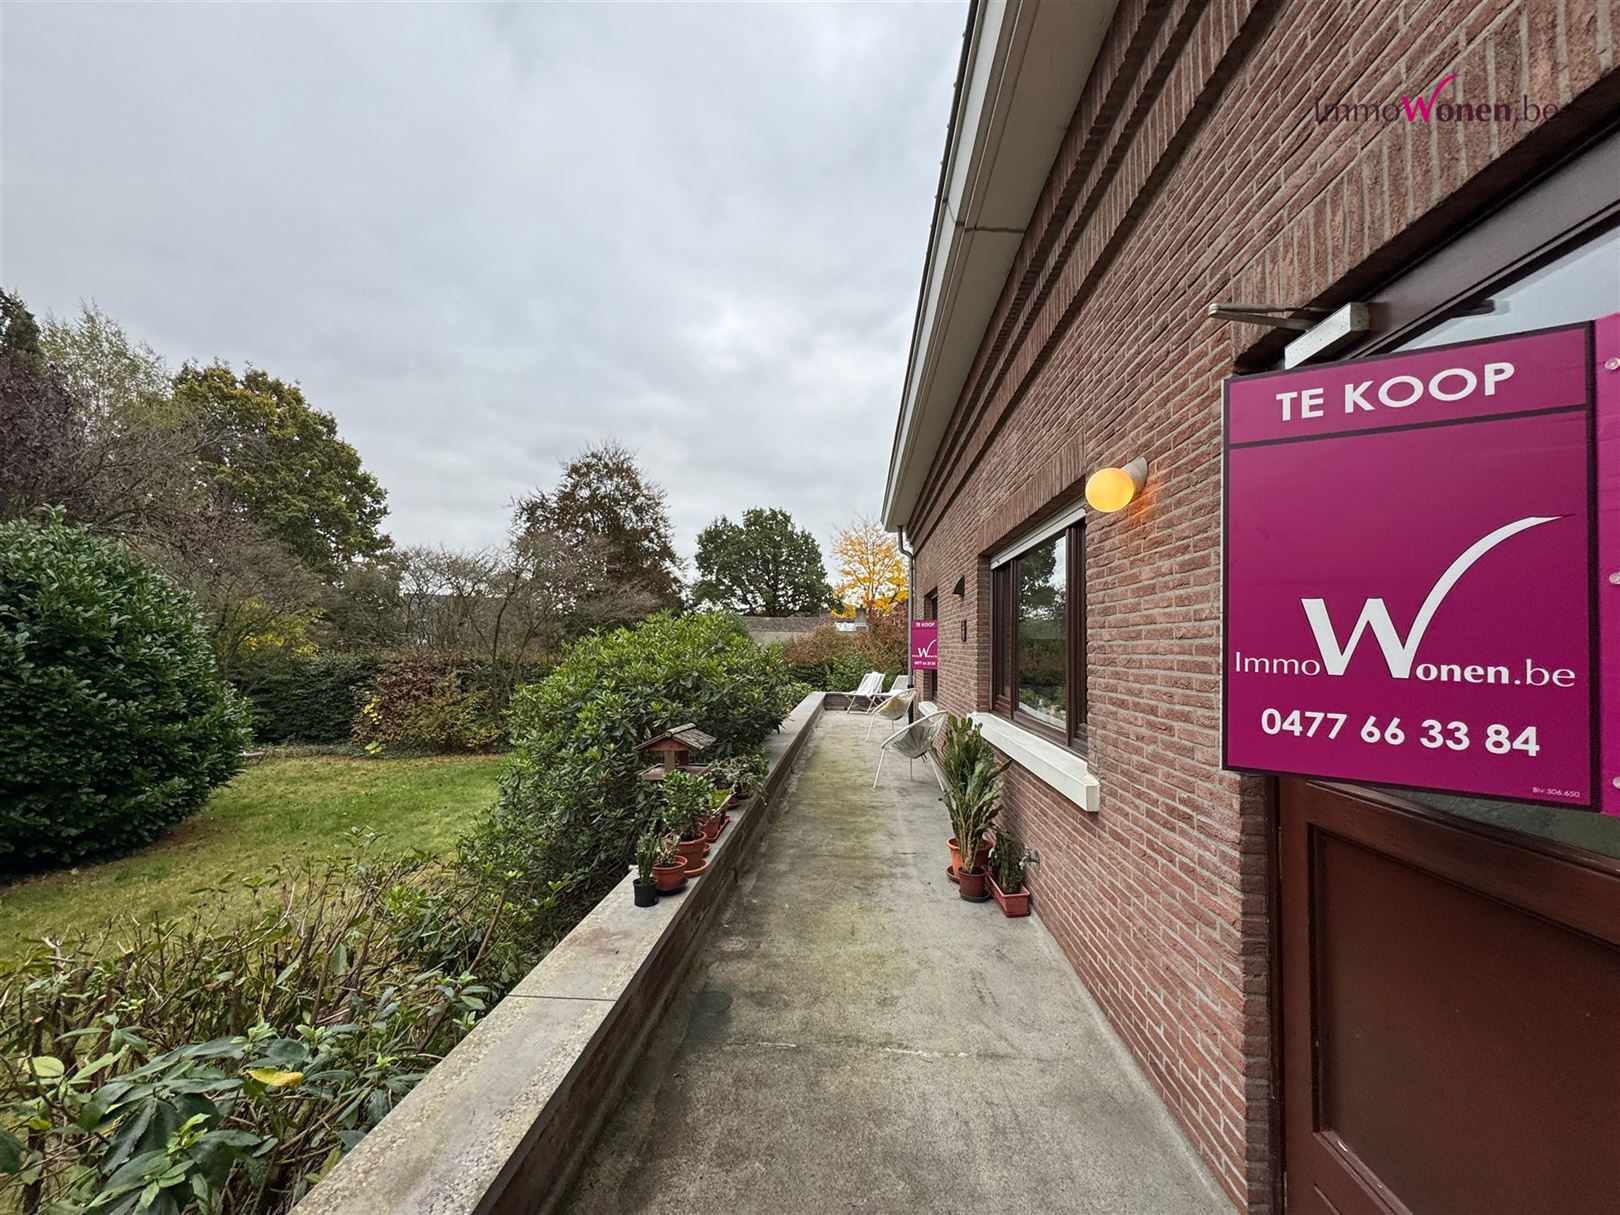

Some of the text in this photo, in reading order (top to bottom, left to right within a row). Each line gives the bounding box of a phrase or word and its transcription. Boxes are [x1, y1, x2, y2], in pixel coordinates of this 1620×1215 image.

[1276, 362, 1515, 421] TE KOOP
[1235, 515, 1576, 687] ImmoWonen.be
[1261, 708, 1540, 757] 0477 66 33 84
[1546, 788, 1580, 798] 506.650
